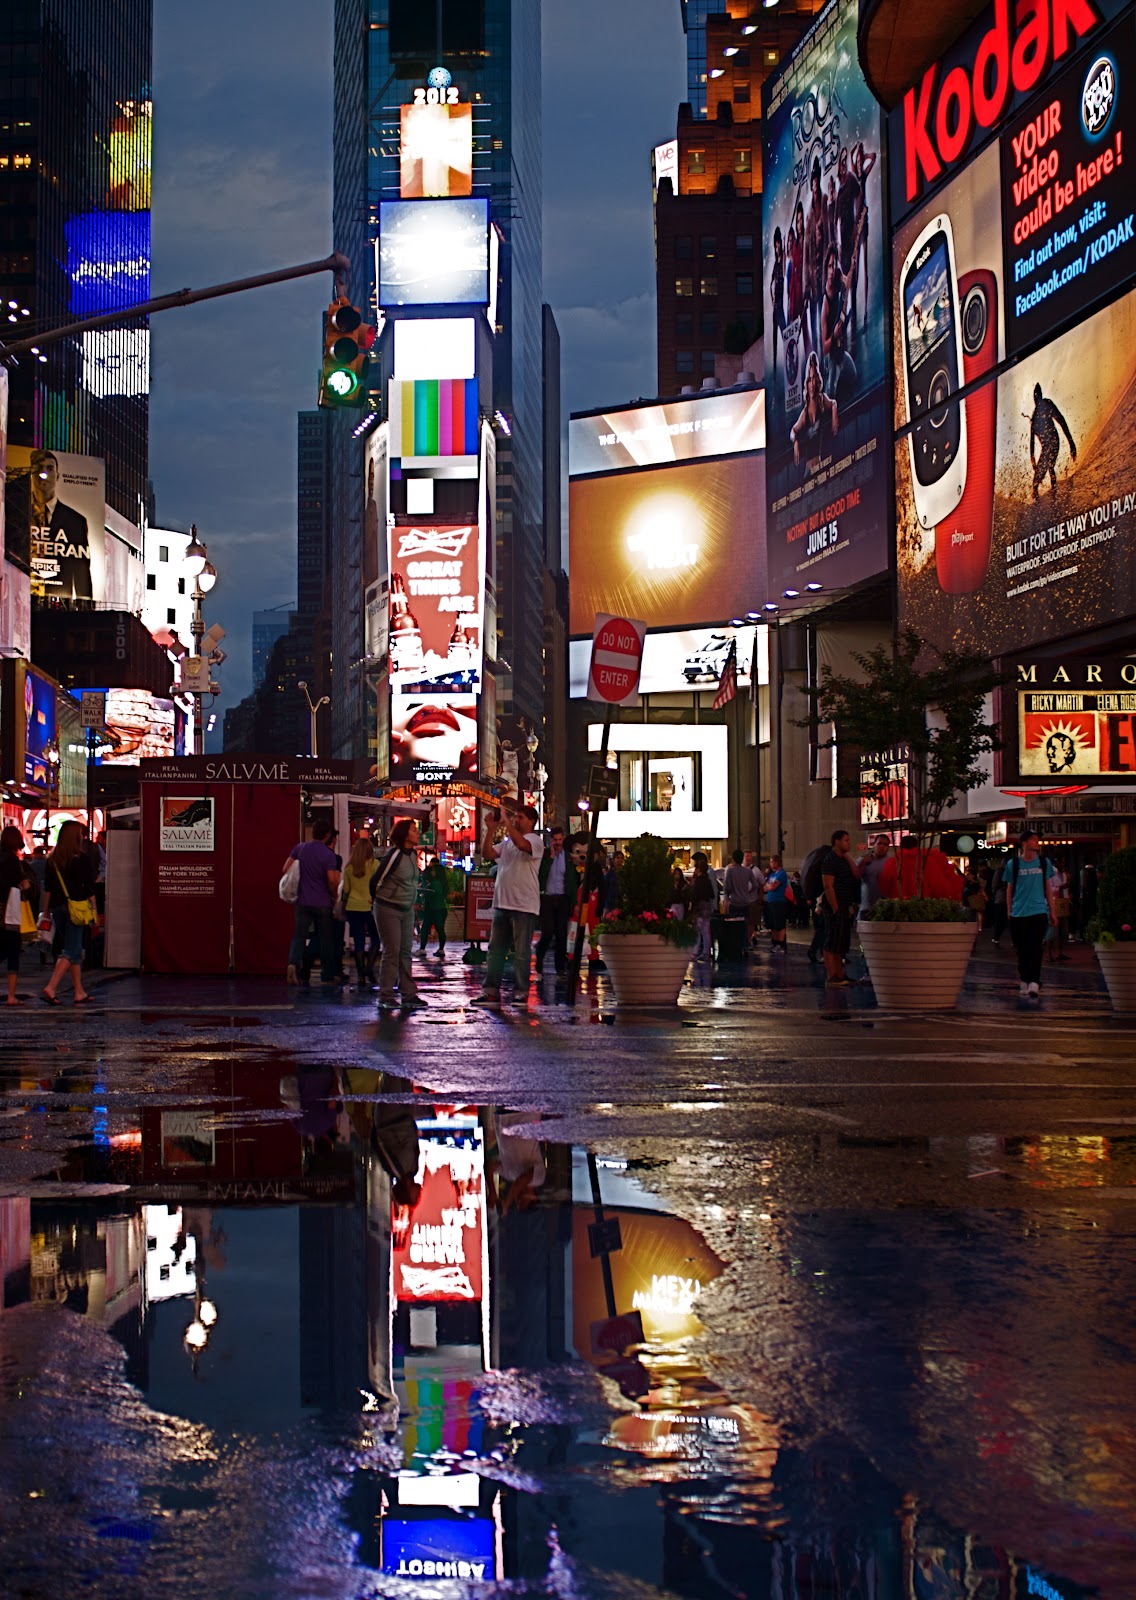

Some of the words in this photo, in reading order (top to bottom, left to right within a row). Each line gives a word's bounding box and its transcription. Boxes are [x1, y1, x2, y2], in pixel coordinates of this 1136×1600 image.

[413, 87, 459, 104] 2012
[904, 0, 1097, 203] Kodak
[1011, 100, 1062, 168] YOUR
[1012, 149, 1059, 207] video
[1013, 187, 1052, 245] could
[1054, 180, 1074, 213] be
[1014, 249, 1035, 282] Find
[1036, 238, 1053, 266] out
[1054, 224, 1078, 254] how,
[1079, 201, 1107, 234] visit:
[1015, 214, 1135, 317] Facebook.com/KODAK
[599, 433, 615, 446] THE
[809, 514, 819, 531] BUT
[820, 511, 825, 525] A
[825, 497, 845, 522] GOOD
[846, 488, 860, 511] TIME
[55, 528, 68, 543] A
[806, 525, 828, 556] JUNE
[828, 520, 838, 544] 15
[1006, 538, 1027, 563] BUILT
[1029, 530, 1047, 553] FOR
[1047, 522, 1065, 545] THE
[1066, 512, 1088, 537] WAY
[1089, 503, 1110, 528] YOU
[1006, 557, 1043, 579] WATERPROOF.
[1042, 540, 1080, 565] SHOCKPROOF.
[1080, 526, 1117, 550] DUSTPROOF.
[406, 561, 464, 578] GREAT
[408, 579, 461, 596] TIMES
[437, 595, 475, 612] ARE
[602, 632, 614, 646] DO
[617, 635, 635, 650] NOT
[600, 670, 629, 687] ENTER
[1017, 664, 1136, 685] MARQ
[1032, 694, 1054, 711] RICKY
[1056, 694, 1084, 711] MARTIN
[1097, 694, 1119, 711] ELENA
[416, 772, 453, 781] SONY
[419, 783, 443, 796] HAVE
[1050, 797, 1062, 814] TIM
[1065, 796, 1083, 813] RICE
[1008, 820, 1056, 834] BEAUTIFUL
[470, 880, 484, 888] FREE
